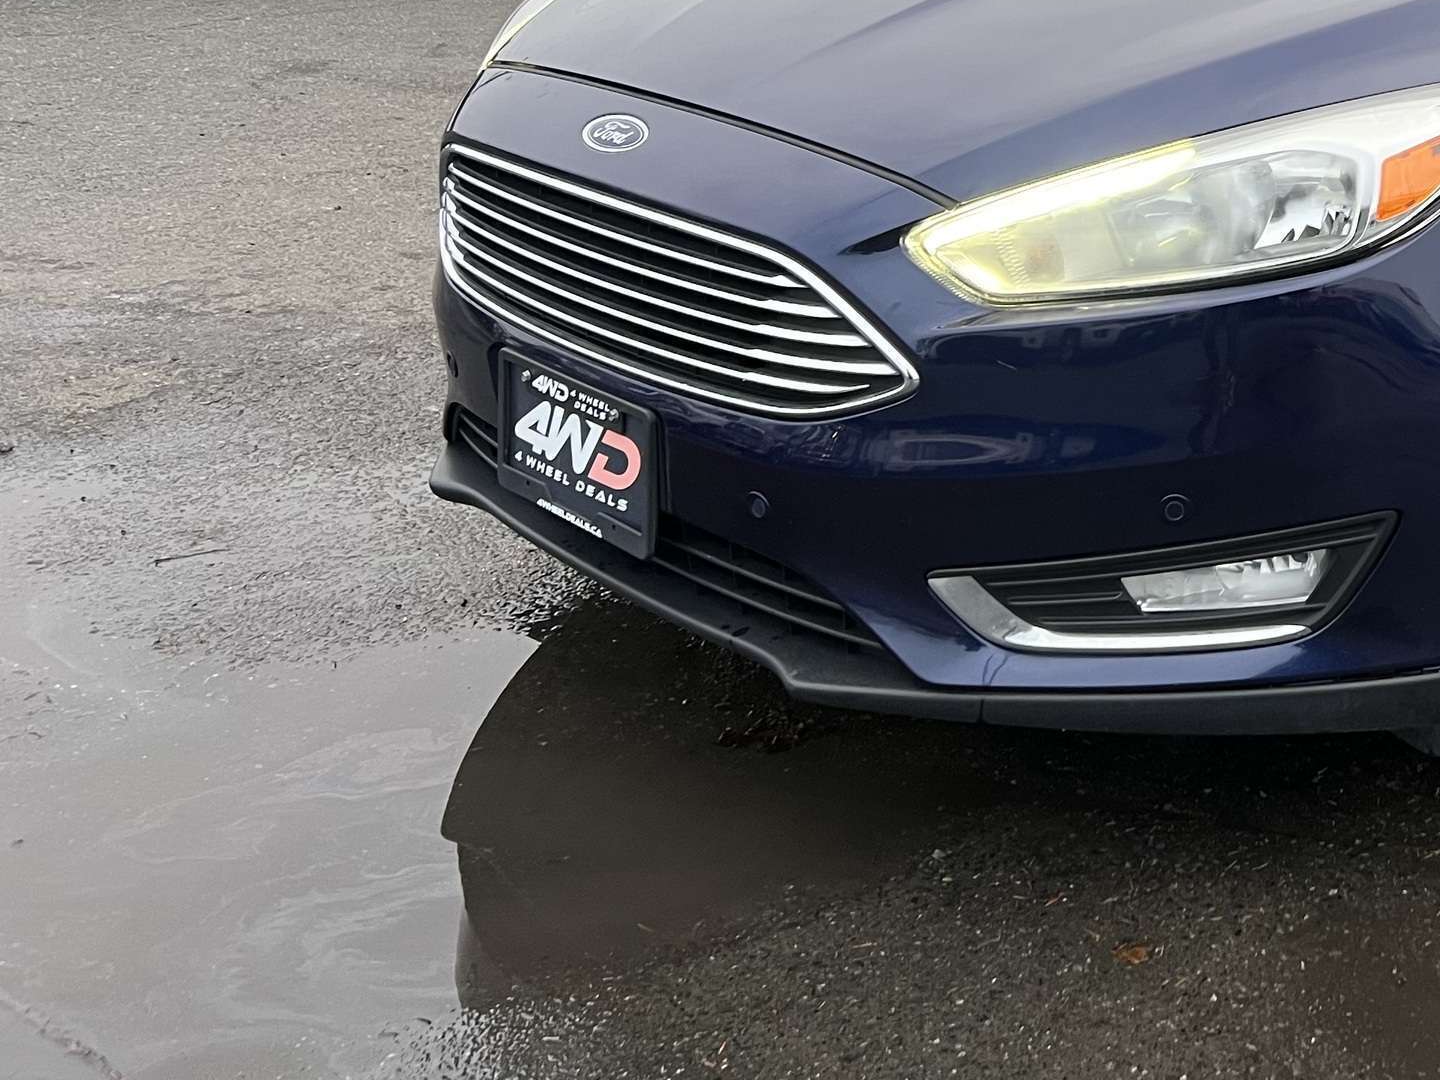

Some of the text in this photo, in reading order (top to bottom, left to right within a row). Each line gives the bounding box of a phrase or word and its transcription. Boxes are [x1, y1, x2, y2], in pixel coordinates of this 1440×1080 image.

[592, 121, 634, 144] Ford
[531, 374, 569, 402] 4WD
[573, 400, 608, 421] DEALS
[578, 392, 611, 413] WHEEL
[514, 400, 642, 491] 4WD
[514, 450, 630, 513] 4 WHEEL DEALS
